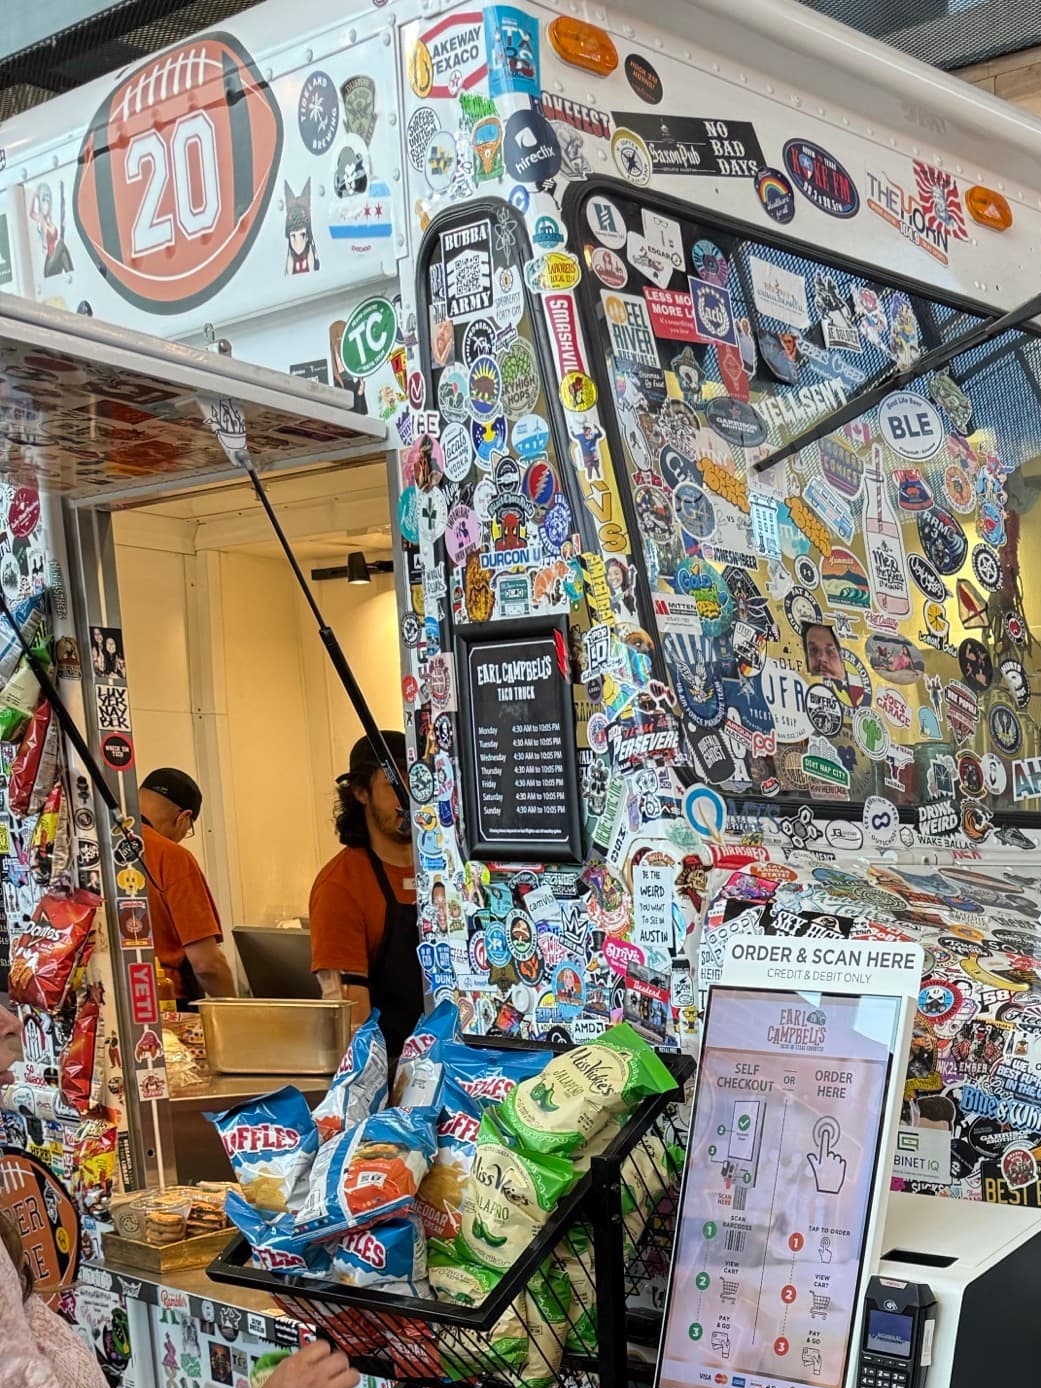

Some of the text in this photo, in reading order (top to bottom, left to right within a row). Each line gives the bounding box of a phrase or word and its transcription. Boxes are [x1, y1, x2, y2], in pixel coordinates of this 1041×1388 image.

[432, 46, 479, 75] TEXACO
[703, 120, 728, 138] NO
[710, 139, 745, 157] BAD
[515, 144, 555, 175] hireclix
[718, 158, 759, 177] DAYS
[126, 110, 220, 259] 20
[867, 172, 900, 214] THE
[445, 226, 488, 251] BUBBA
[449, 292, 491, 317] ARMY
[645, 289, 672, 304] LESS
[652, 304, 683, 316] MORE
[348, 313, 385, 360] TC
[613, 325, 655, 358] RIVER
[507, 389, 531, 403] HOPS
[888, 412, 934, 440] BLE
[480, 550, 529, 569] DURCON
[668, 600, 697, 610] MITTEN
[477, 655, 551, 685] EARL CAMPBELL'S
[497, 686, 535, 701] TACO TRUCK
[810, 694, 837, 706] BIKERS
[881, 692, 907, 712] JOE'S
[876, 698, 910, 727] GARAGE
[479, 727, 498, 736] Monday
[726, 728, 751, 746] NATION
[479, 740, 498, 749] Tuesday
[613, 730, 679, 762] PERSEVERE
[480, 754, 506, 762] Wednesday
[481, 767, 502, 776] Thursday
[482, 781, 496, 790] Friday
[483, 793, 503, 802] Saturday
[484, 806, 501, 816] Sunday
[918, 802, 955, 821] DRINK
[919, 813, 958, 836] WEIRD
[917, 835, 942, 848] WAKE
[713, 843, 766, 865] THRASHER
[640, 885, 665, 898] WEIRD
[23, 920, 63, 942] Doritos
[640, 930, 668, 944] AUSTIN
[731, 944, 916, 970] ORDER & SCAN HERE
[767, 968, 872, 984] CREDIT & DEBIT ONLY
[133, 967, 154, 1022] YETI
[779, 1007, 807, 1026] EARL
[575, 1023, 595, 1034] AMD
[767, 1025, 827, 1046] CAMPBELL'S
[734, 1063, 760, 1075] SELF
[815, 1070, 853, 1084] ORDER
[960, 1063, 988, 1074] EMBER
[997, 1065, 1019, 1078] BEST
[716, 1075, 775, 1092] CHECKOUT
[783, 1075, 796, 1085] OR
[816, 1085, 846, 1099] HERE
[961, 1085, 996, 1116] Blue
[985, 1178, 1030, 1206] BEST
[831, 1228, 850, 1236] ORDER
[700, 1373, 712, 1381] VISA
